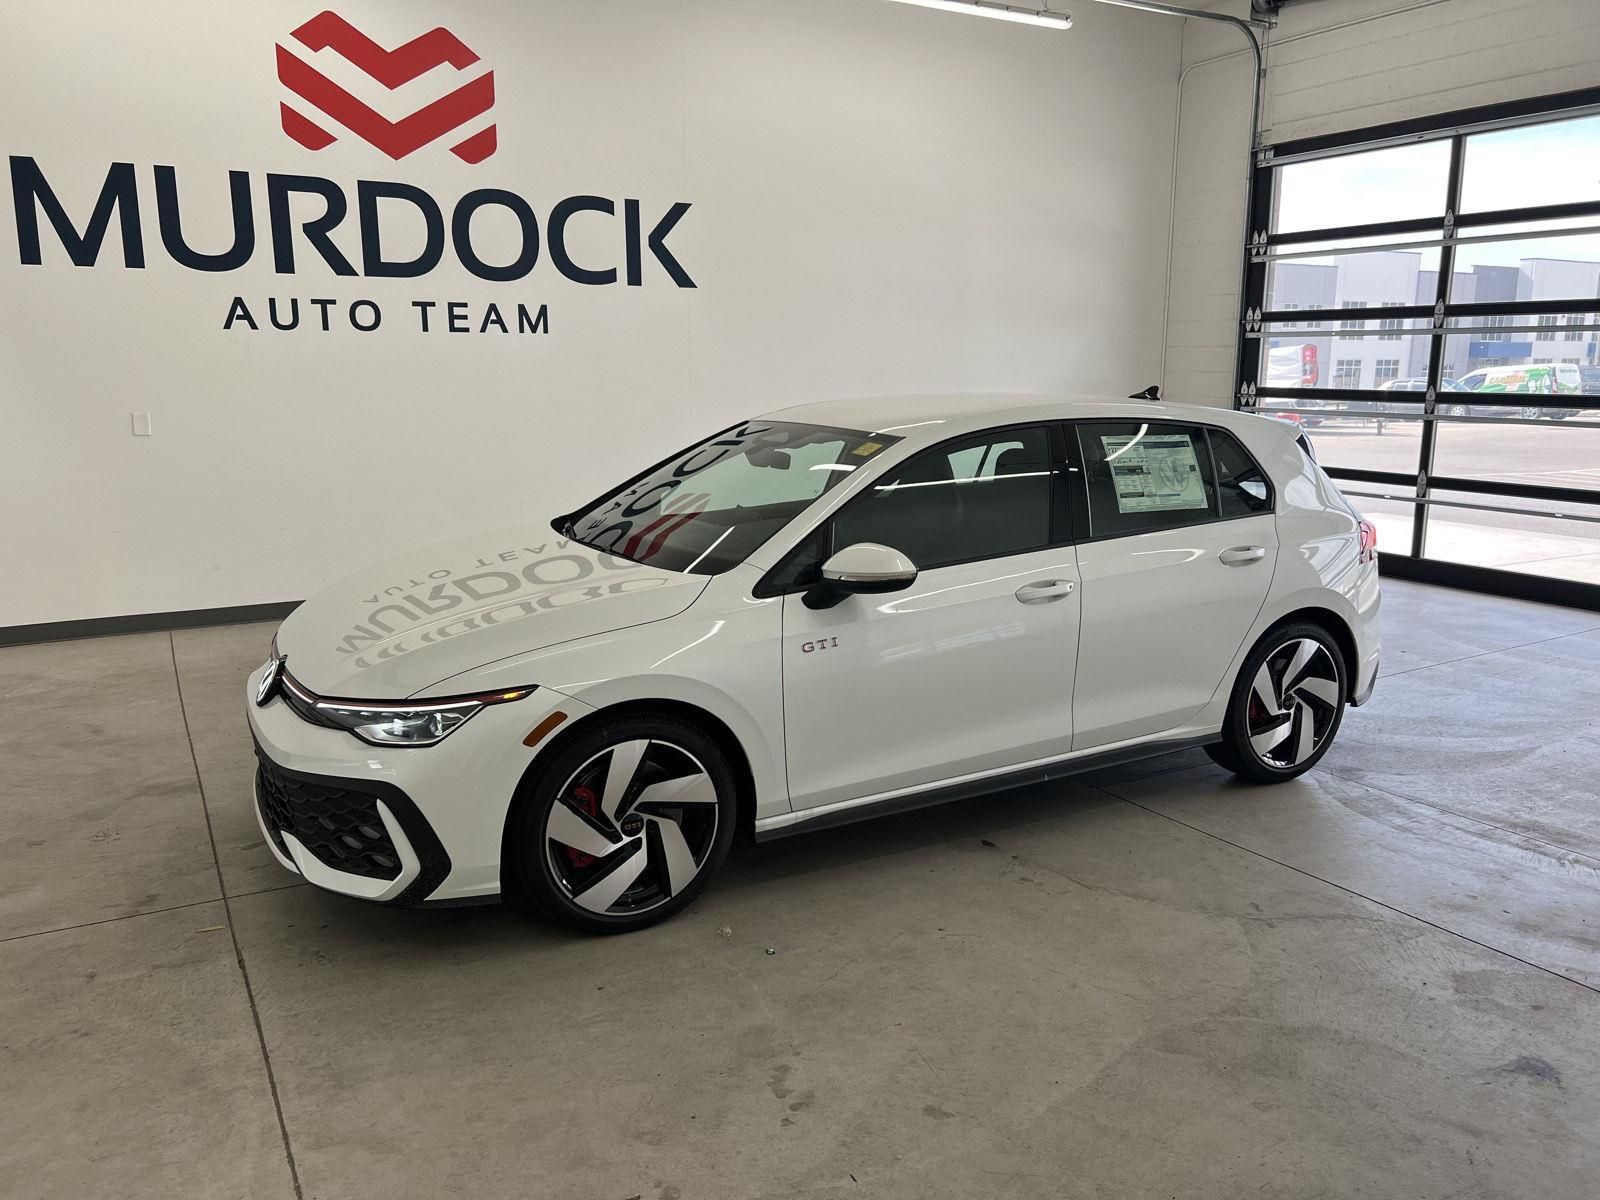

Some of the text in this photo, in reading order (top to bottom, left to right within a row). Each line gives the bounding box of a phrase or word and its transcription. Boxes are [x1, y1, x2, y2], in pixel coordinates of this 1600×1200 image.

[9, 156, 697, 288] MURDOCK
[223, 297, 548, 334] AUTO TEAM
[801, 637, 838, 653] GTI
